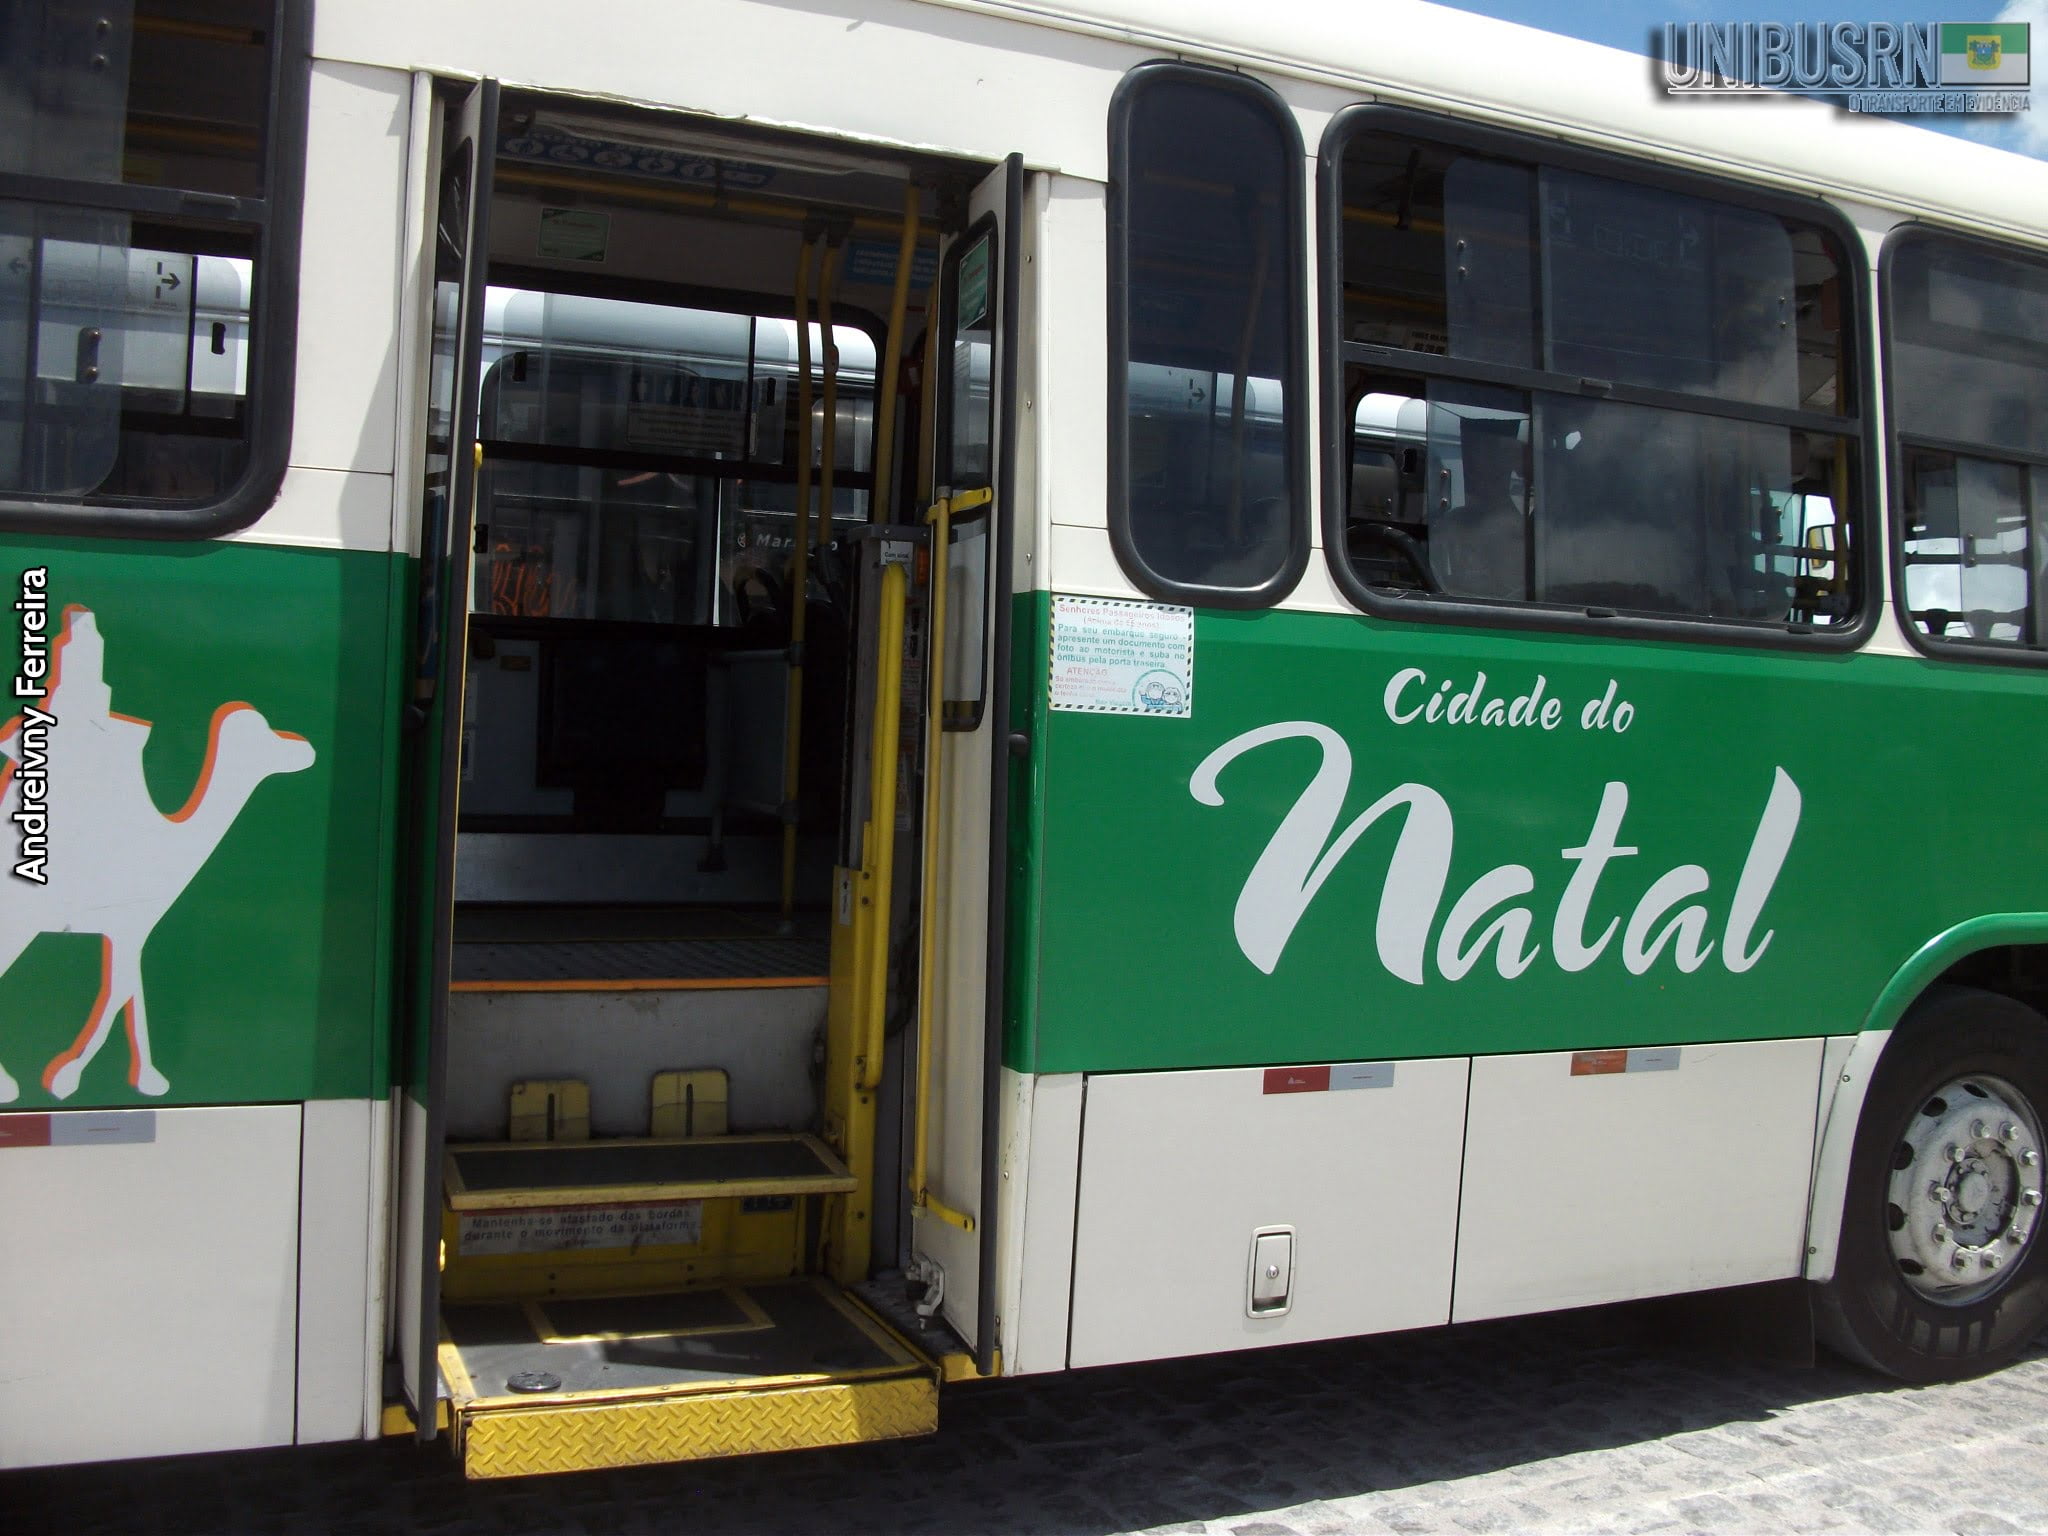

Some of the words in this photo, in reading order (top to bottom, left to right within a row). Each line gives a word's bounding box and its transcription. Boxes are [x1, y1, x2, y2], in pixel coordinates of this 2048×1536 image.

[1058, 603, 1101, 616] Senhores
[1103, 607, 1155, 621] Passageiros
[1058, 623, 1078, 633] Para
[1102, 626, 1145, 639] embarque
[1149, 631, 1179, 641] seguro
[1056, 634, 1101, 646] apresente
[1102, 638, 1116, 646] um
[1118, 636, 1166, 649] documento
[1167, 643, 1186, 651] com
[1057, 642, 1075, 652] foto
[1094, 646, 1136, 657] motorista
[1149, 649, 1171, 660] suba
[1174, 653, 1186, 661] no
[1088, 655, 1108, 667] pela
[1109, 657, 1133, 669] porta
[1384, 667, 1563, 730] Cidade
[1580, 677, 1635, 733] do
[1189, 720, 1802, 986] Natal
[472, 1215, 553, 1229] Mantenha-se
[560, 1210, 613, 1224] afastado
[620, 1209, 641, 1221] das
[464, 1229, 513, 1241] durante
[520, 1229, 528, 1239] o
[534, 1224, 604, 1239] movimento
